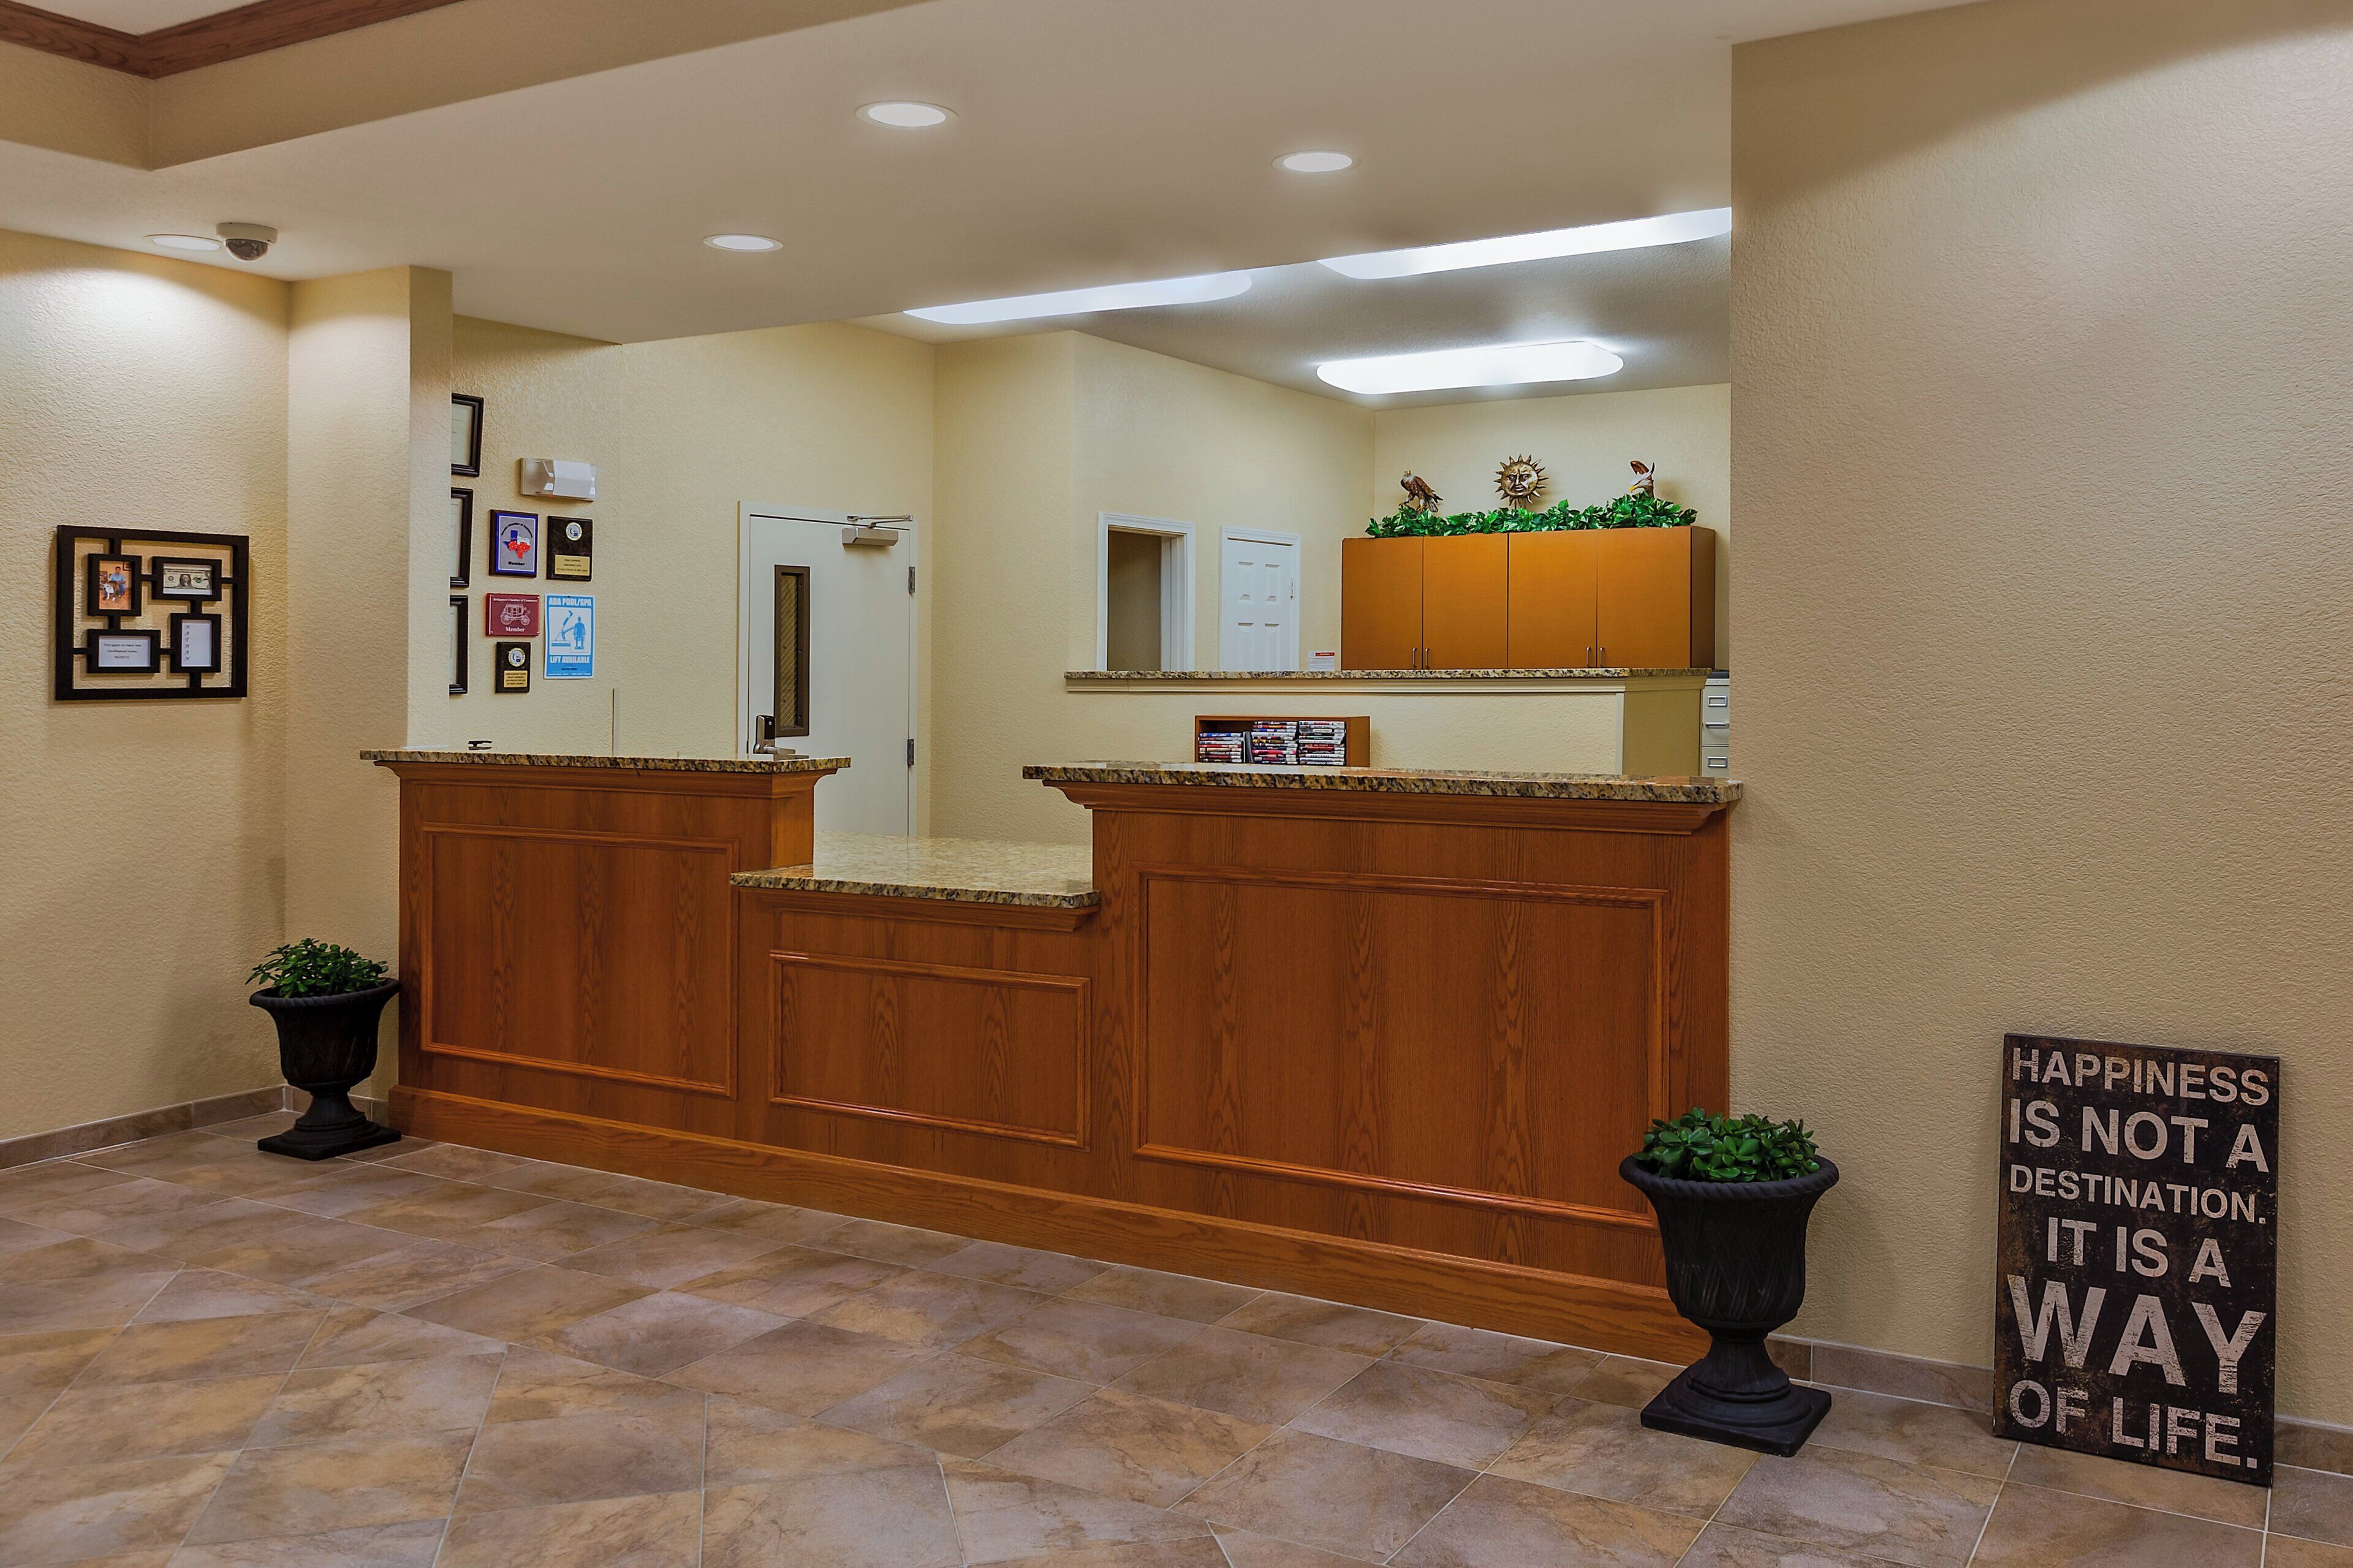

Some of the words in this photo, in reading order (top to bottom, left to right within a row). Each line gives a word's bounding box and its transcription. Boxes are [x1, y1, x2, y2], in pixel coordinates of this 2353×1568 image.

[563, 597, 592, 607] POOL/SPA
[2012, 1047, 2270, 1106] HAPPINESS
[2009, 1097, 2060, 1148] IS
[2081, 1105, 2207, 1164] NOT
[2225, 1124, 2269, 1173] A
[2010, 1164, 2267, 1224] DESTINATION.
[2047, 1217, 2097, 1267] IT
[2115, 1226, 2168, 1278] IS
[2188, 1238, 2231, 1288] A
[2007, 1274, 2267, 1395] WAY
[2009, 1379, 2089, 1434] OF
[2112, 1396, 2258, 1469] LIFE.
